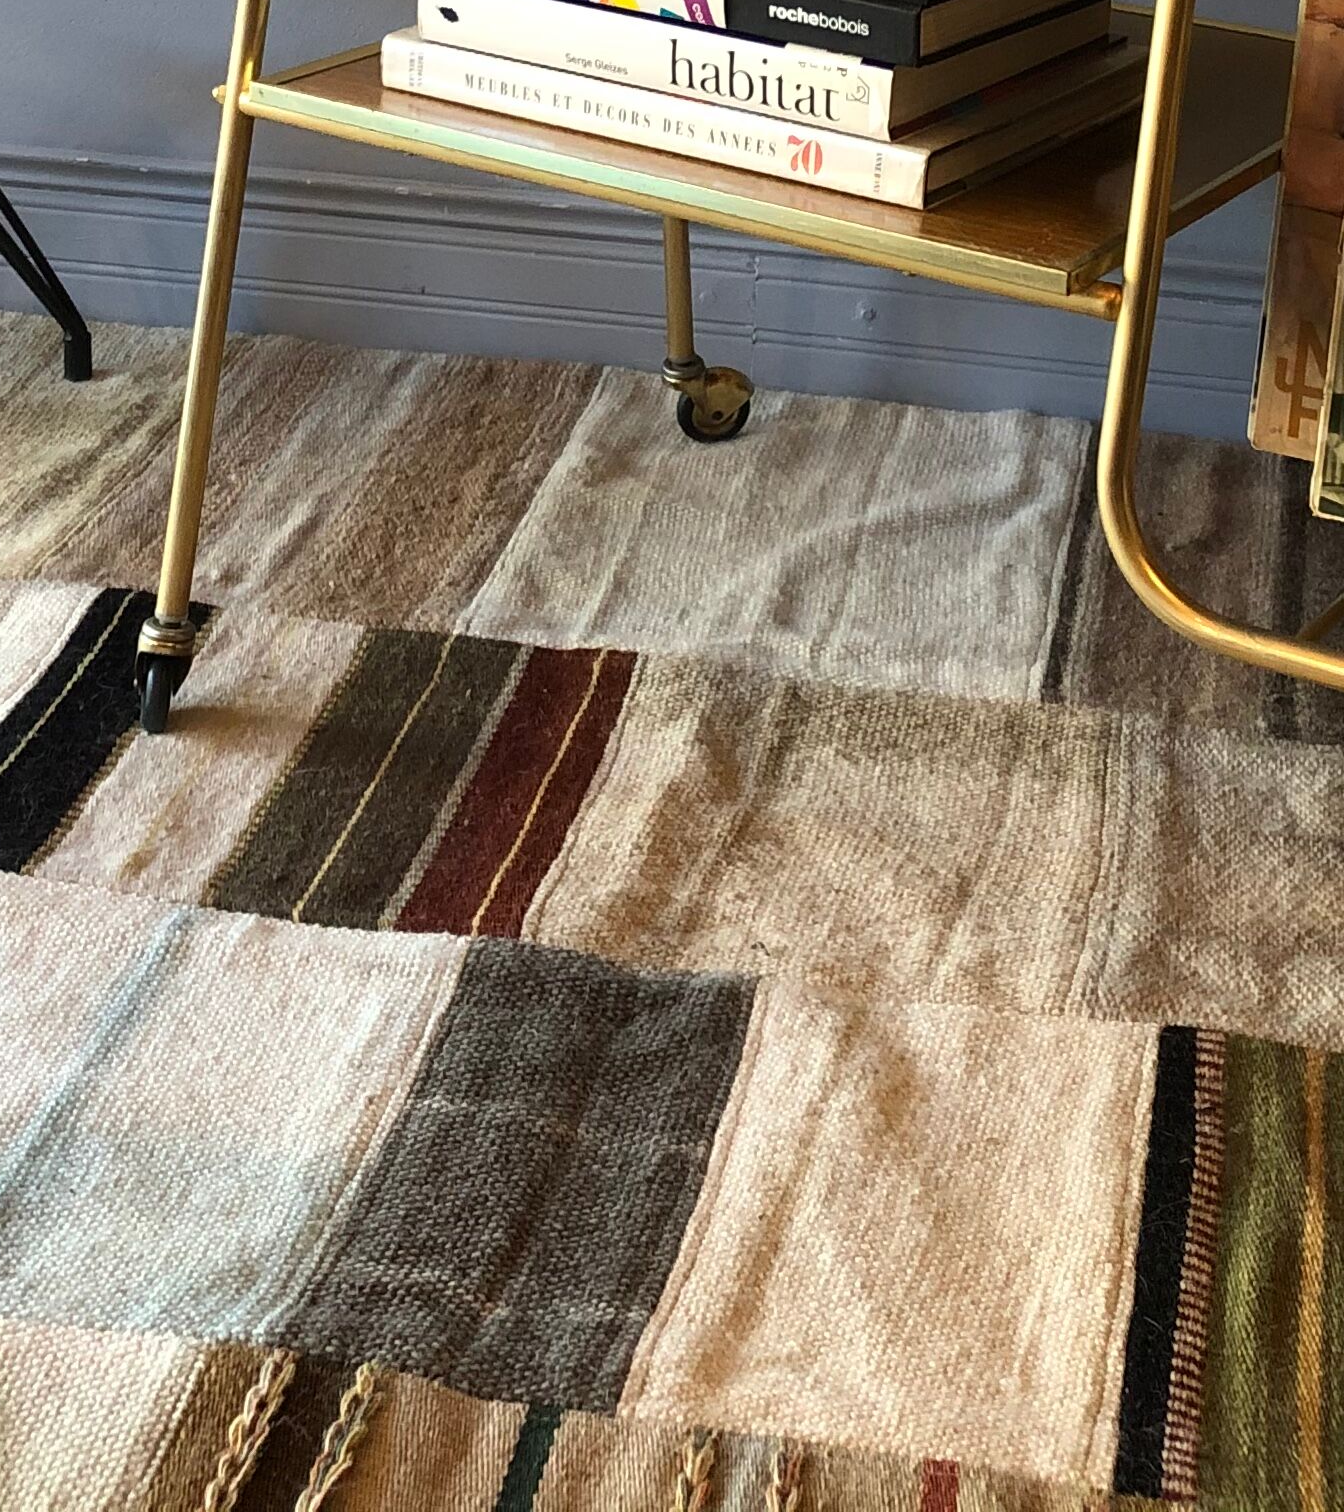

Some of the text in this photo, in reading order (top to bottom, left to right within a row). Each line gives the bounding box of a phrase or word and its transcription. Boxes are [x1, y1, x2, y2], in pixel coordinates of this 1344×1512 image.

[768, 4, 870, 37] rochebobois
[564, 52, 593, 69] Serge
[669, 38, 841, 123] habitat
[464, 73, 824, 176] MEUBLES ET DECORS DES ANNEES 70
